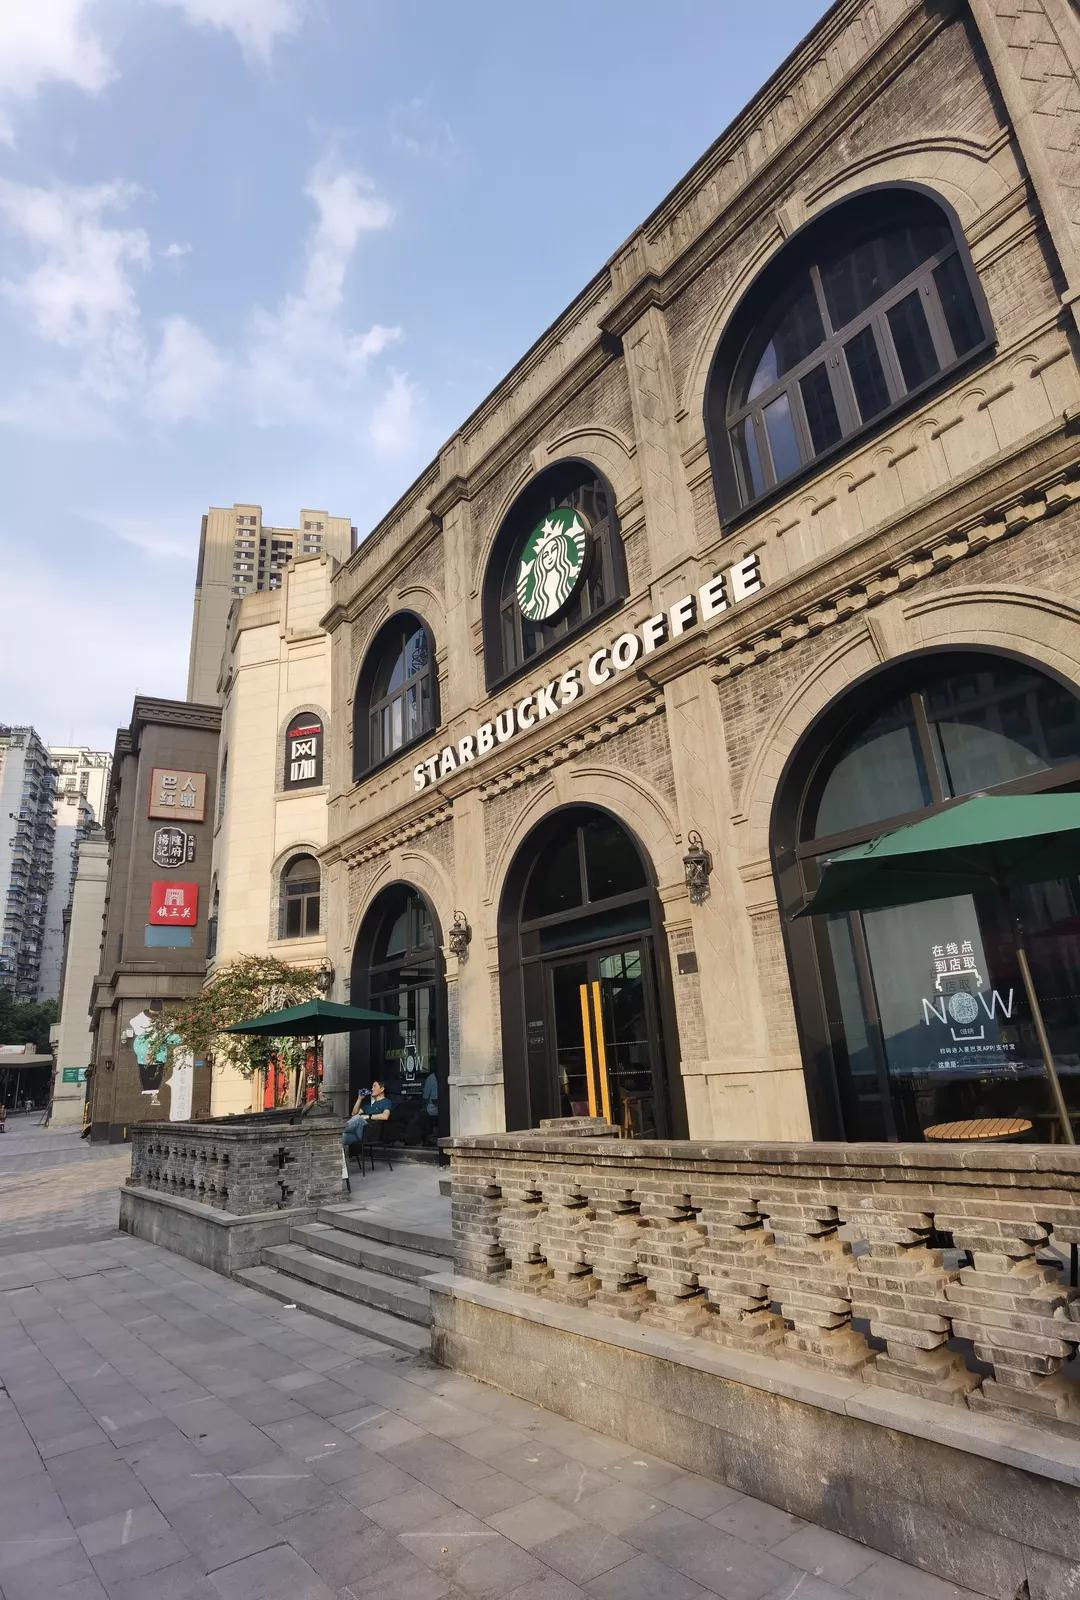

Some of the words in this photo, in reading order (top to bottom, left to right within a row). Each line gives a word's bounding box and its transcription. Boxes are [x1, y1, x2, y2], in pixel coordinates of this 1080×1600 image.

[414, 669, 580, 792] STARBUCKS
[588, 553, 764, 686] COFFEE
[291, 738, 316, 781] 网咖
[932, 941, 974, 957] 在线点
[935, 956, 977, 973] 到店取
[922, 988, 1014, 1026] NOW
